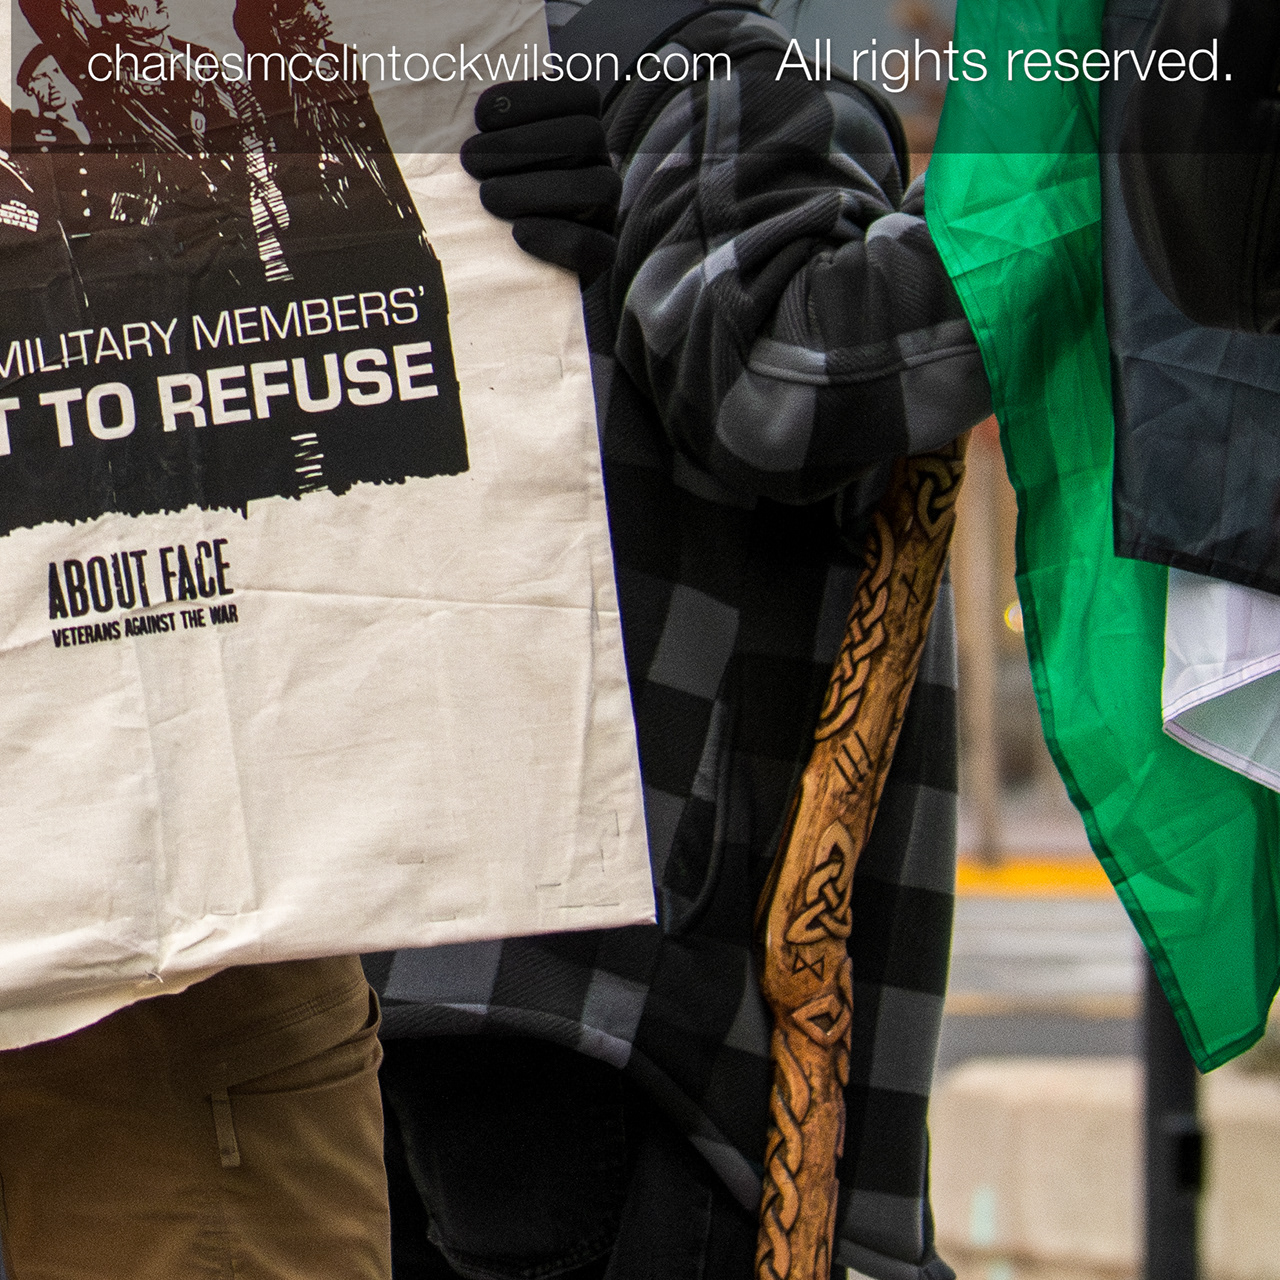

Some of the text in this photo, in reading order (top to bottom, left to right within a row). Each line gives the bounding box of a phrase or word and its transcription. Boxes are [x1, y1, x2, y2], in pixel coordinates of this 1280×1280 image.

[39, 381, 136, 448] TO
[157, 341, 439, 432] REFUSE
[49, 538, 234, 620] ABOUT FACE
[52, 604, 239, 648] VETERANS AGAINST THE WAR
